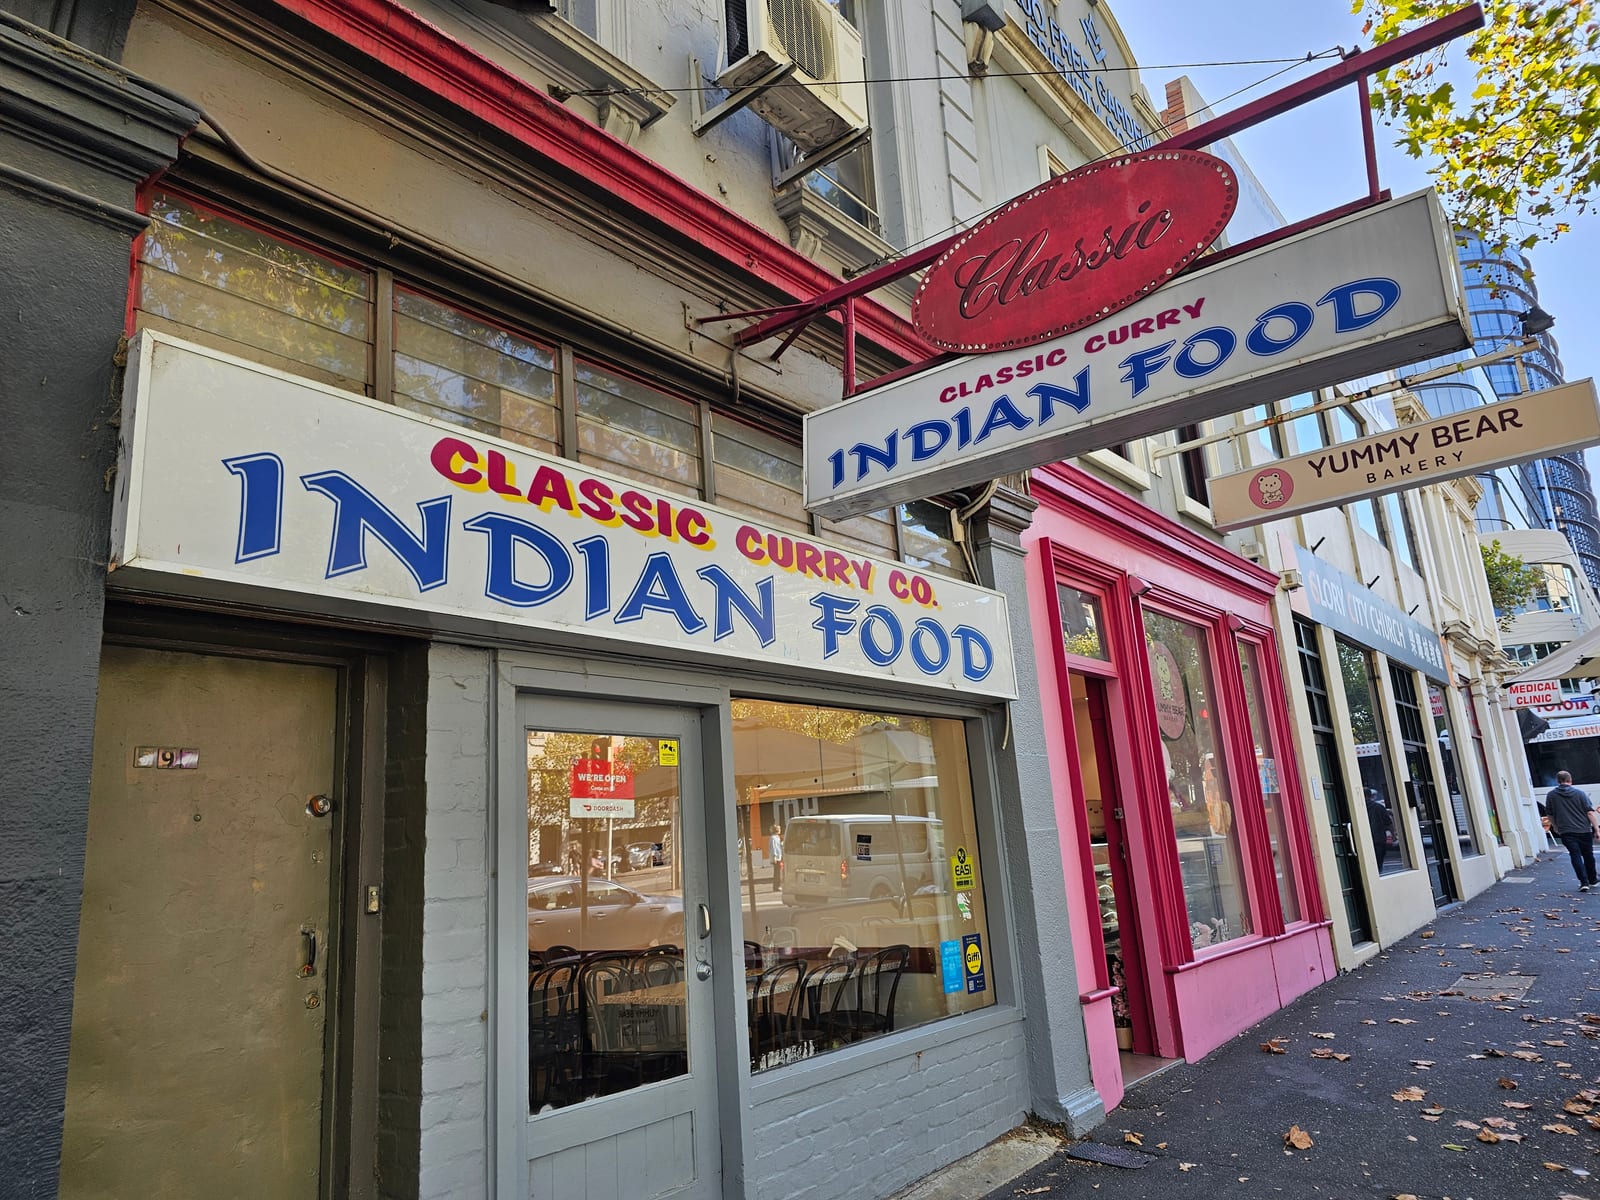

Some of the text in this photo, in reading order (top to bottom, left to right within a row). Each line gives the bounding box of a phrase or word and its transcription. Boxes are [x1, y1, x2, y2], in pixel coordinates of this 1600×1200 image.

[1048, 16, 1092, 91] FREE
[954, 201, 1174, 320] Classic
[828, 277, 1402, 490] INDIAN FOOD
[939, 297, 1208, 404] CLASSIC CURRY
[1307, 407, 1523, 478] YUMMY BEAR
[1366, 450, 1465, 484] BAKERY
[430, 437, 942, 611] CLASSIC CURRY CO.
[221, 452, 994, 683] INDIAN FOOD
[1308, 570, 1407, 649] GLORY CITY CHURCH
[1509, 682, 1558, 695] MEDICAL
[1516, 694, 1552, 705] CLINIC
[1566, 725, 1600, 737] shuttl
[604, 774, 627, 784] OPEN
[955, 864, 972, 876] EASI
